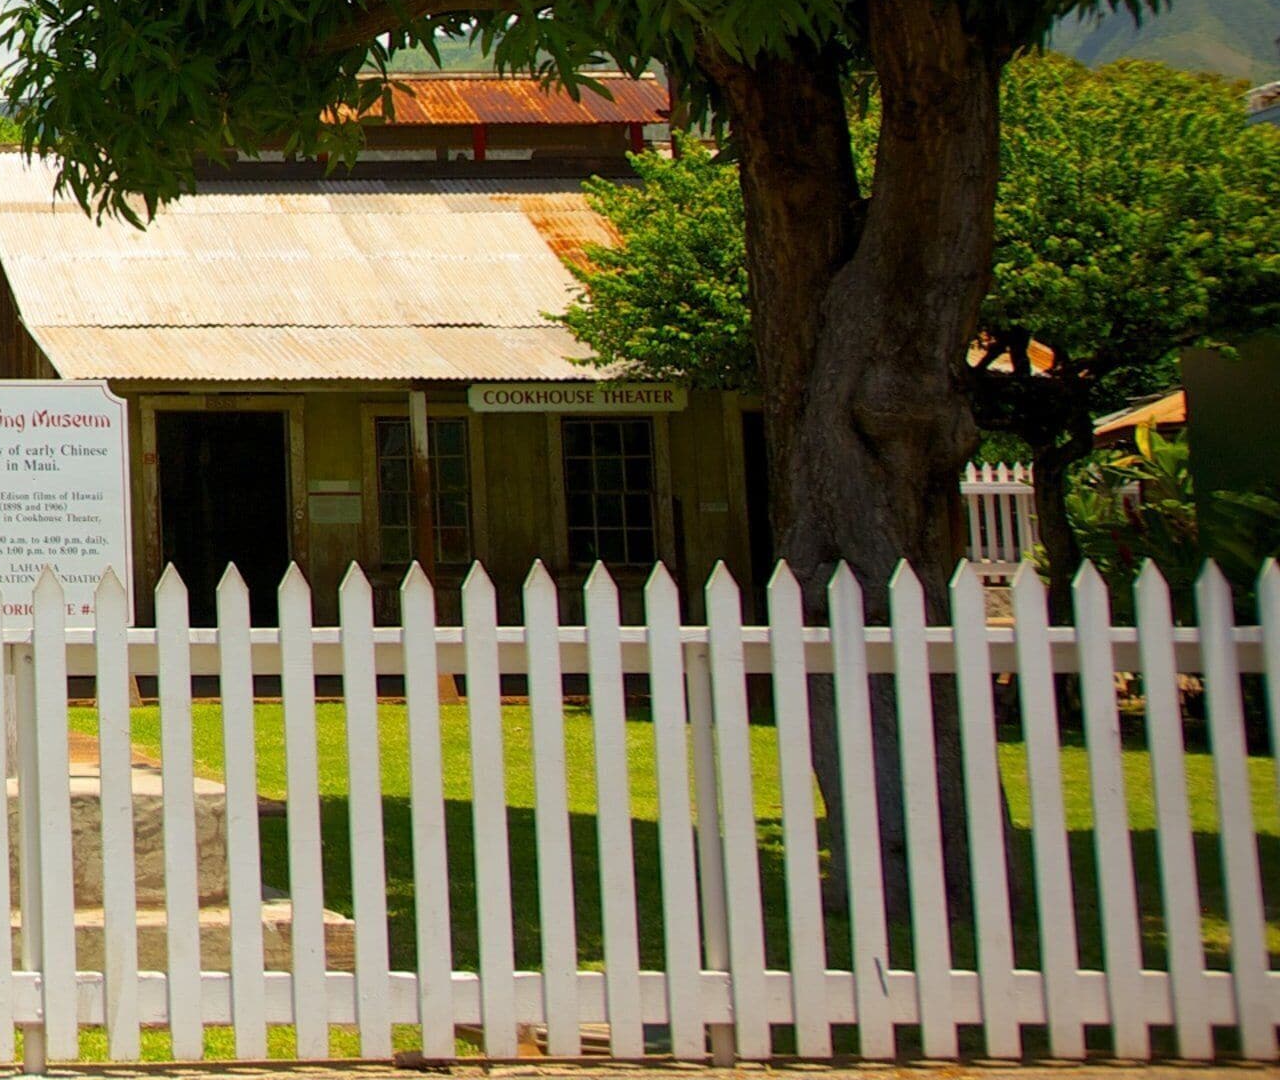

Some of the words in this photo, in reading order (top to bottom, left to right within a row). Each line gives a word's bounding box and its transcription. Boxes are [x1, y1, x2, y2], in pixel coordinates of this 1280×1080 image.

[483, 389, 594, 405] COOKHOUSE
[603, 389, 674, 405] THEATER
[32, 409, 111, 428] Museum
[8, 444, 21, 456] of
[26, 444, 56, 458] early
[60, 444, 108, 456] Chinese
[6, 460, 18, 471] in
[24, 460, 60, 471] Maui.
[0, 491, 30, 501] Edison
[33, 491, 56, 501] films
[59, 491, 69, 501] of
[72, 491, 103, 501] Hawaii
[0, 503, 23, 512] (1898
[25, 503, 41, 512] and
[3, 514, 13, 522] in
[16, 514, 62, 522] Cookhouse
[7, 546, 24, 555] 1:00
[81, 548, 100, 556] p.m.
[11, 563, 60, 573] LAHAIA
